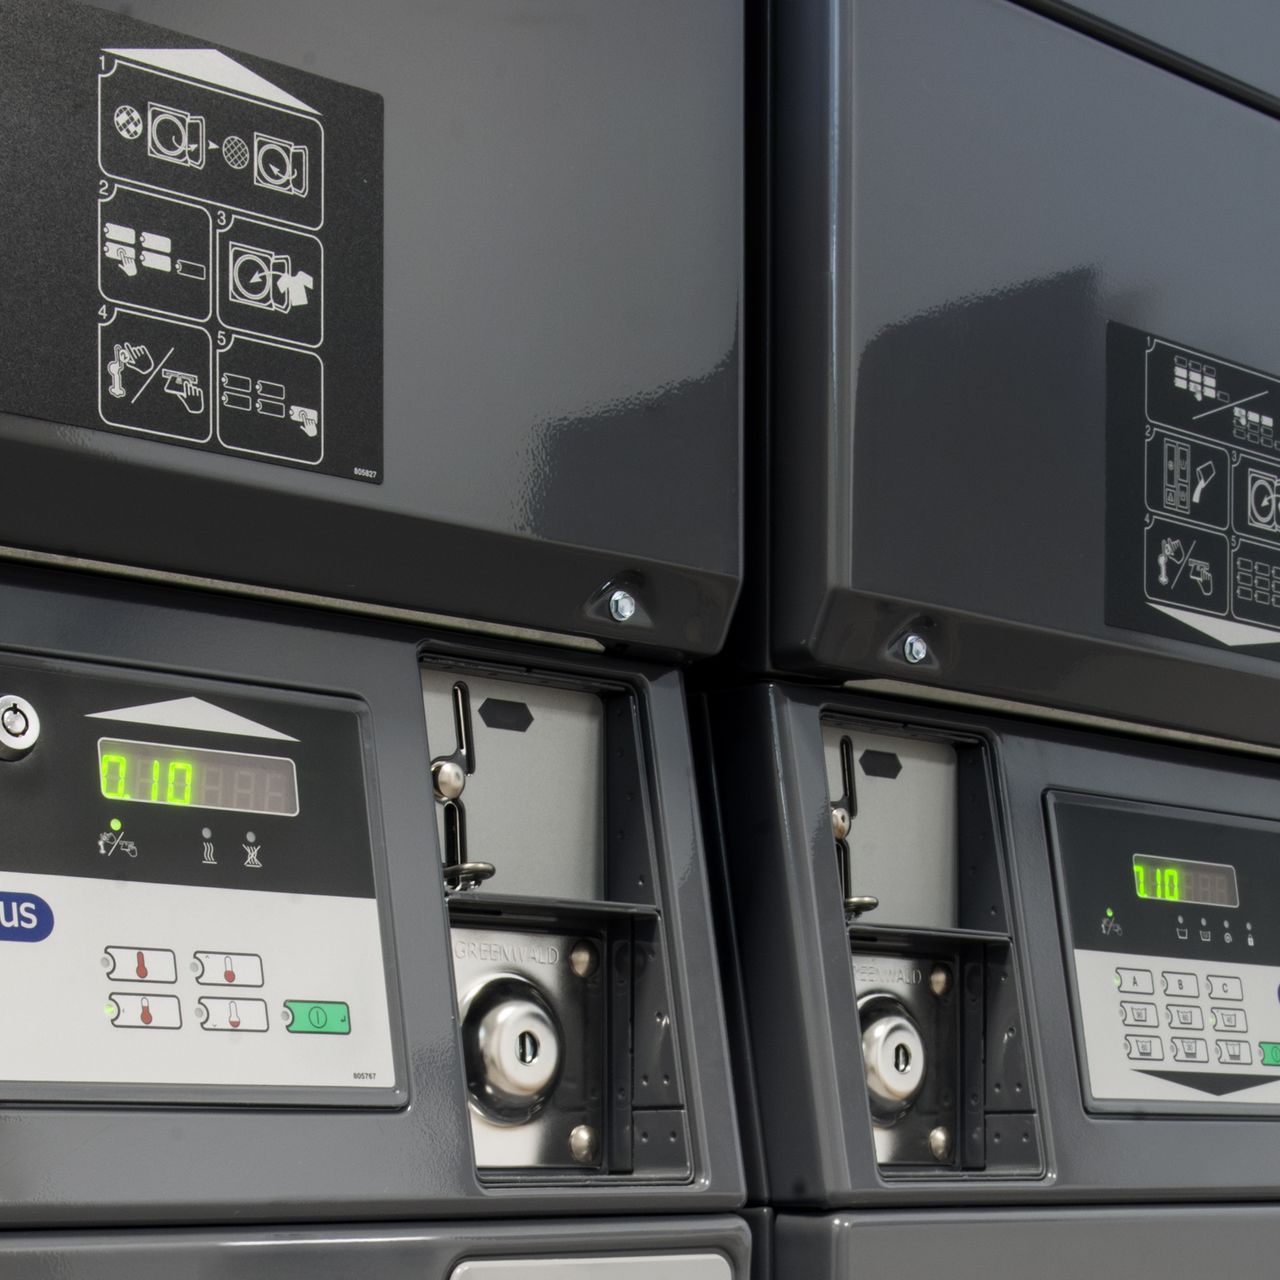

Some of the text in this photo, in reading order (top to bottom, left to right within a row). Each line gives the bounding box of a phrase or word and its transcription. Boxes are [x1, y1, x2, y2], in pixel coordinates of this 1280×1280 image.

[99, 56, 105, 71] 1
[99, 180, 108, 196] 2
[217, 211, 226, 226] 3
[98, 304, 108, 320] 4
[217, 331, 226, 346] 5
[455, 940, 559, 965] GREENWALD
[1132, 976, 1138, 987] A
[1222, 983, 1228, 993] C
